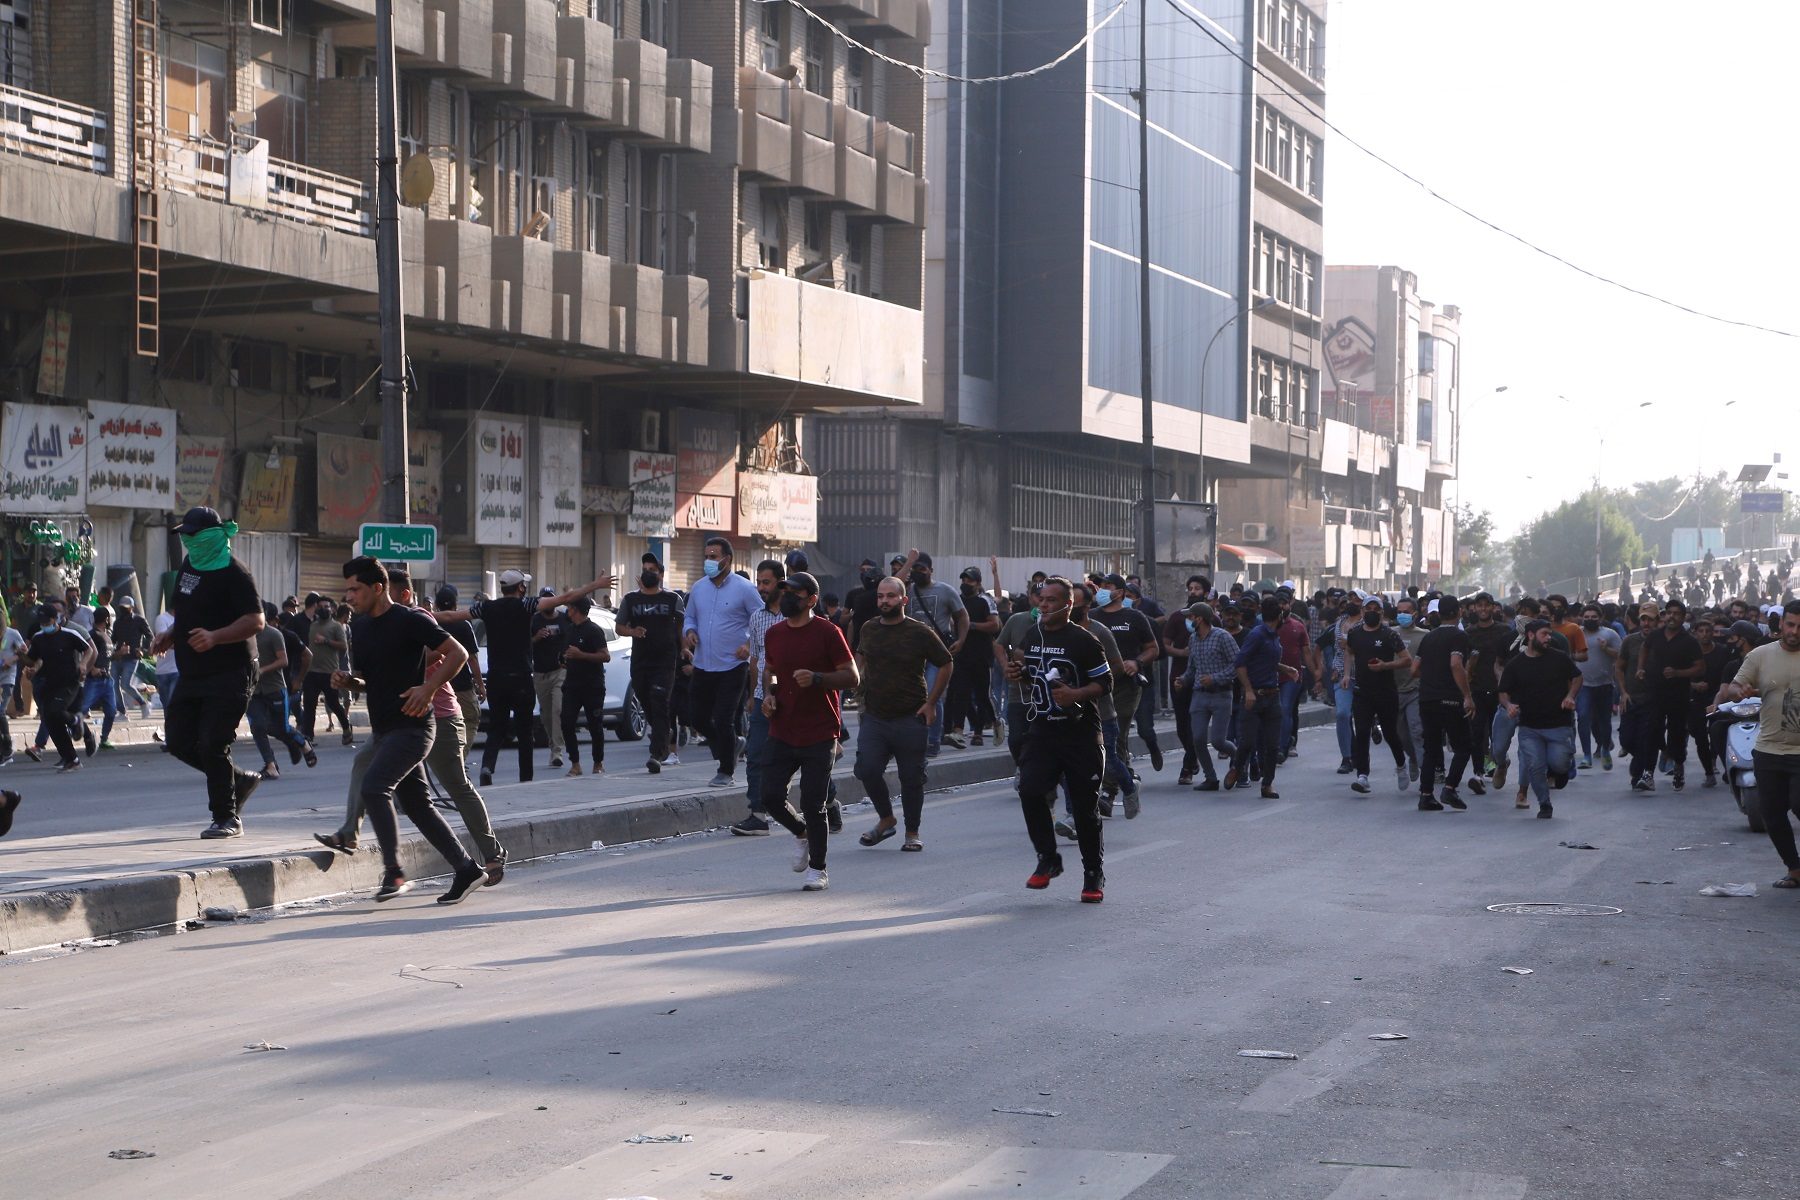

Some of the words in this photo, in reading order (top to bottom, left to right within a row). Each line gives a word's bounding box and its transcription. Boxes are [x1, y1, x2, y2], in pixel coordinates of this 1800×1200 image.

[24, 423, 63, 469] البياع
[687, 494, 720, 528] السلام
[365, 532, 383, 550] لله
[390, 534, 432, 554] الحمد
[631, 603, 670, 616] NIKE
[1030, 645, 1041, 653] LOS
[1041, 646, 1065, 655] ANGELS
